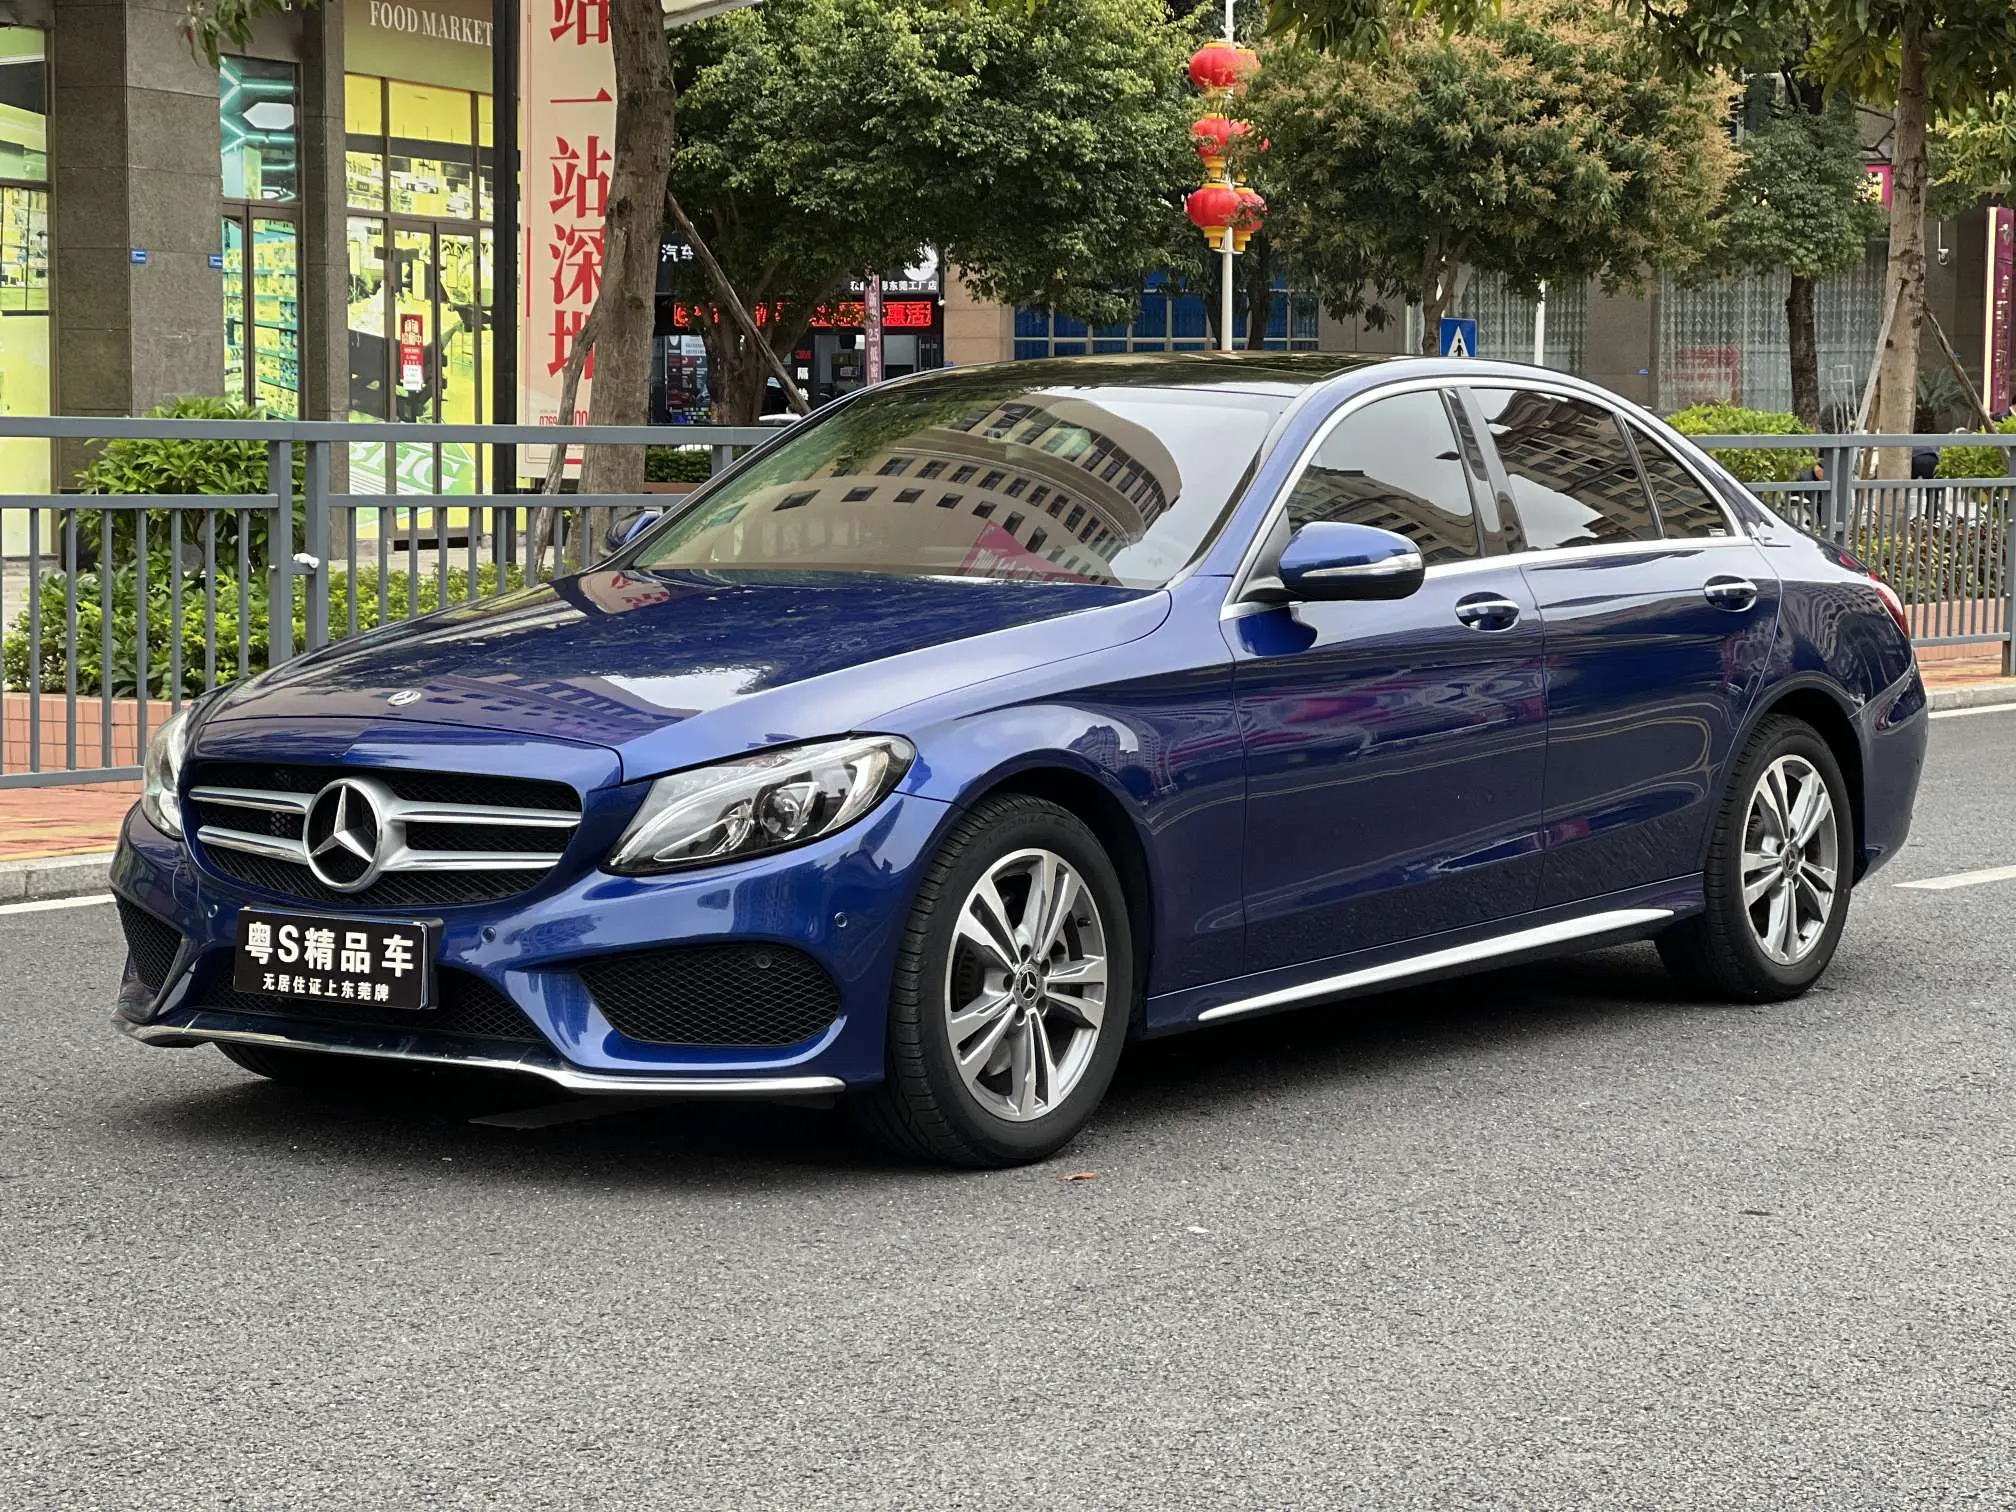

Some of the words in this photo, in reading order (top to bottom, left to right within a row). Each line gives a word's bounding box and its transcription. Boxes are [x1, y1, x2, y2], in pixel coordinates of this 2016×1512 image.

[369, 1, 418, 32] FOOD
[421, 10, 493, 46] MARKET
[262, 972, 390, 1003] 无居住证上东莞牌
